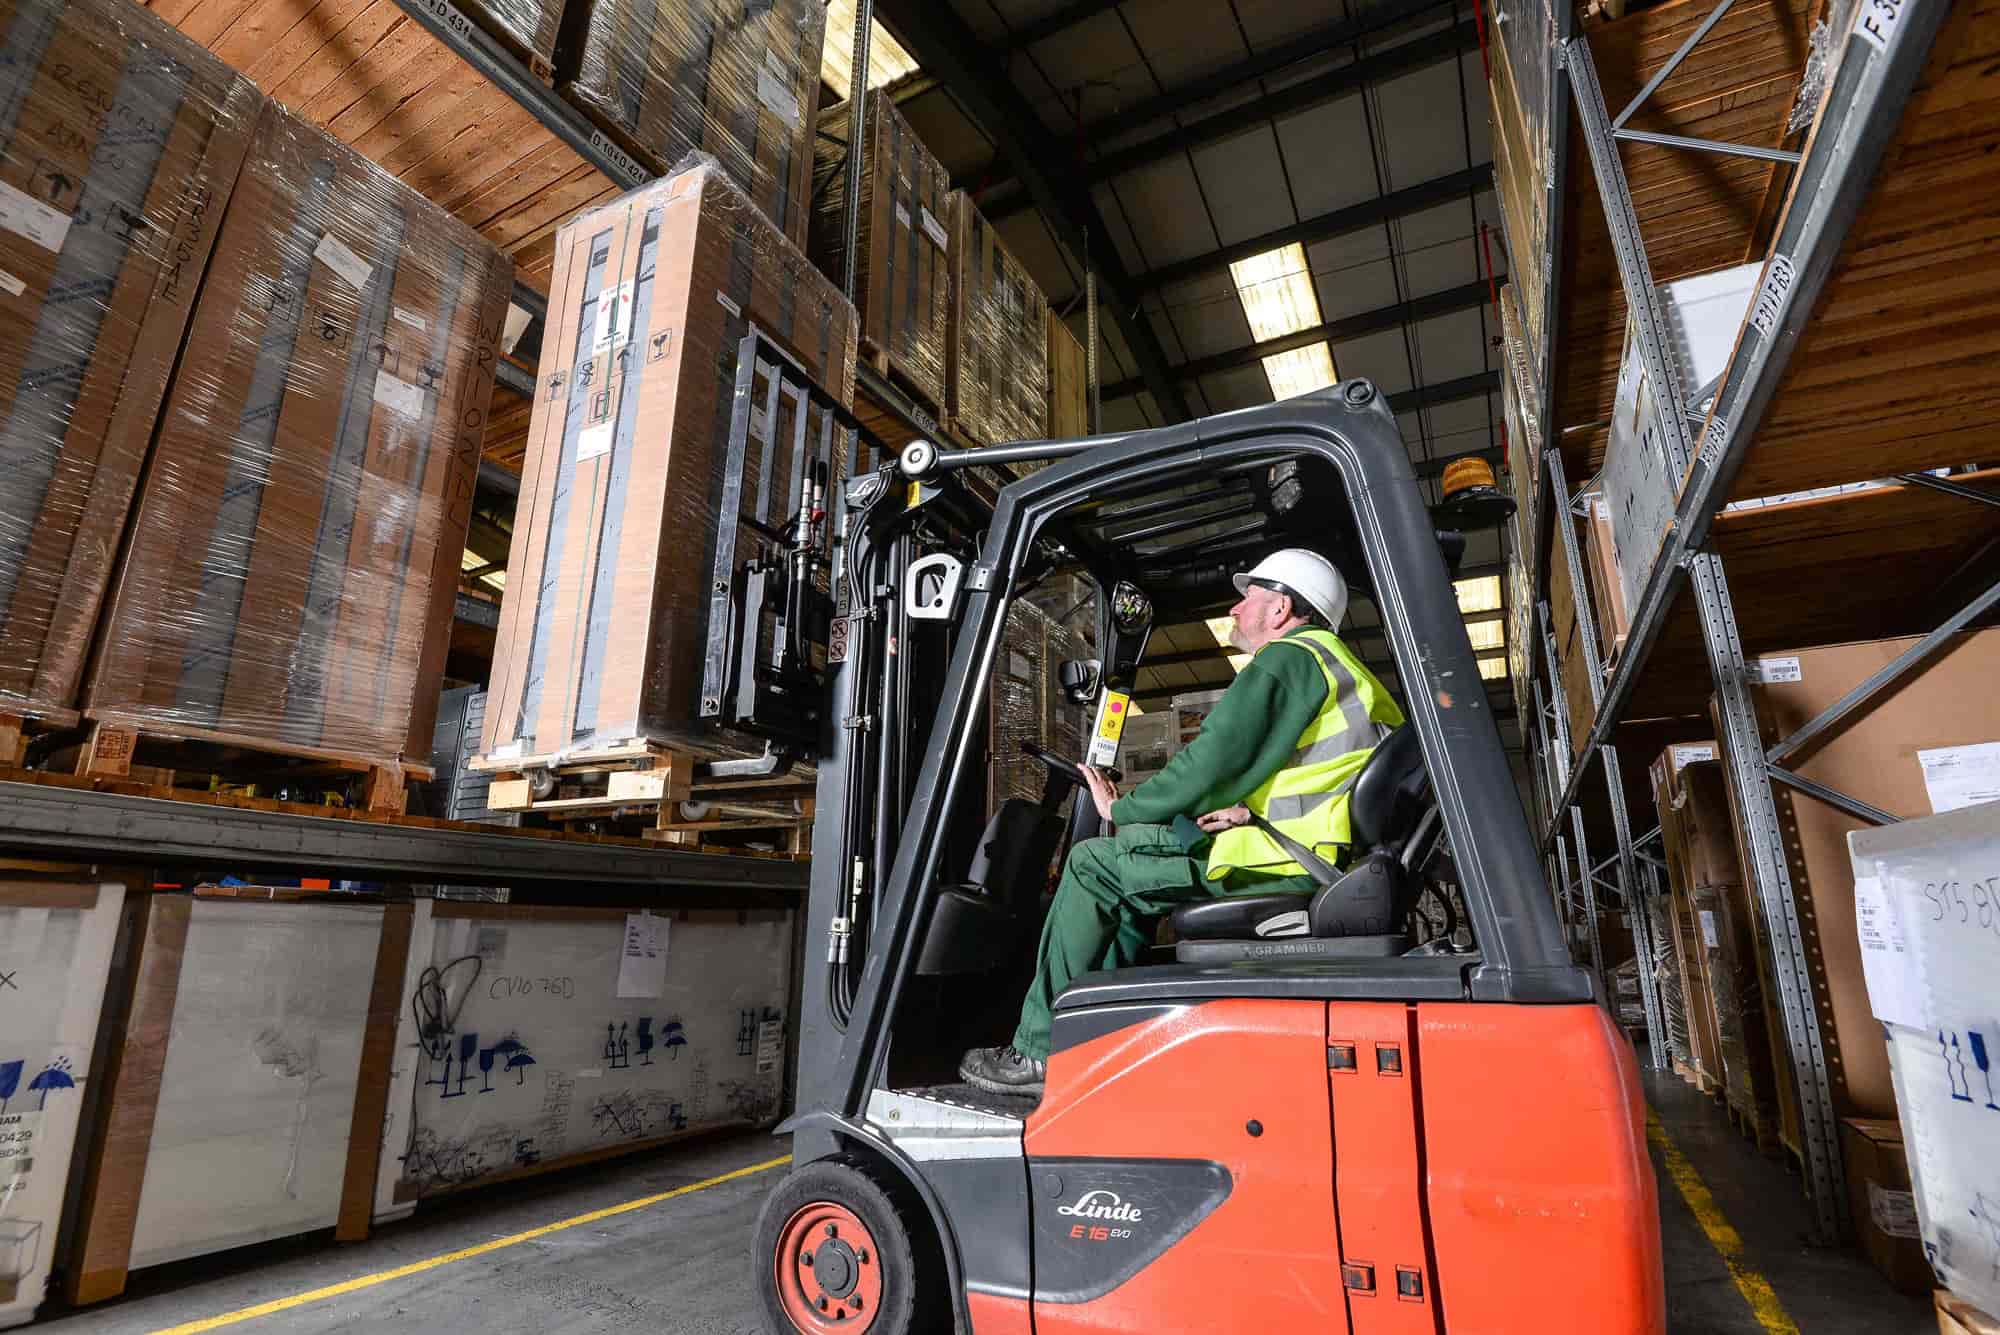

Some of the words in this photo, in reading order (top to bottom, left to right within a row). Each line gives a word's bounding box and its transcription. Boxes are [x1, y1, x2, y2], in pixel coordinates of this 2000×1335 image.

[1873, 0, 1901, 20] 3
[1864, 16, 1885, 43] F
[1255, 943, 1326, 955] GRAMMER
[1057, 1190, 1142, 1222] Linde
[1070, 1224, 1087, 1239] E
[1088, 1225, 1110, 1241] 16
